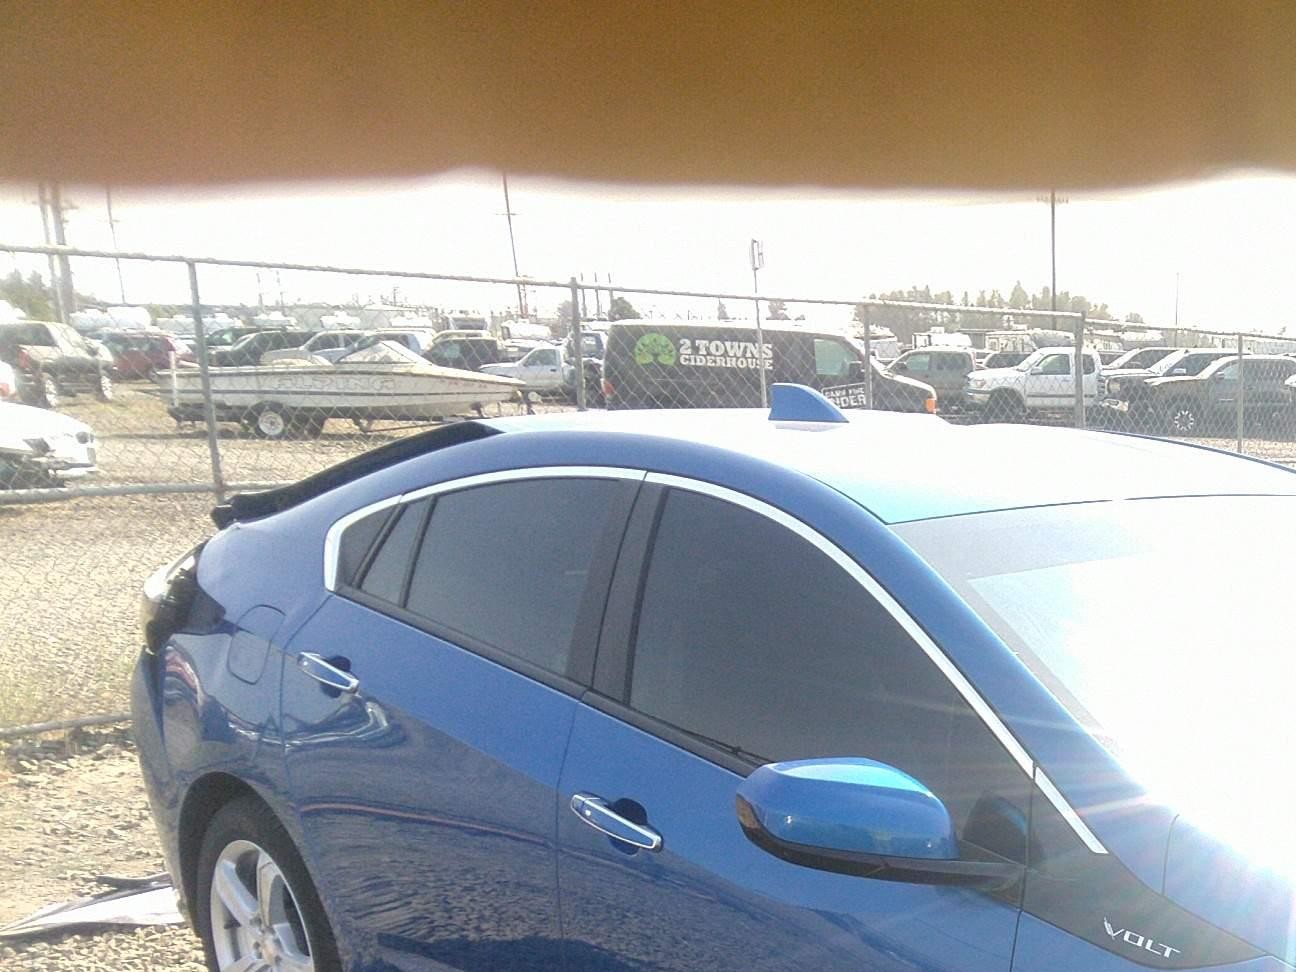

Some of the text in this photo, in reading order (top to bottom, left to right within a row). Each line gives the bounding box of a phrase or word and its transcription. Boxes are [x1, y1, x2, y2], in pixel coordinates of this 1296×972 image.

[679, 338, 774, 359] 2 TOWNS
[679, 354, 774, 371] CIDERHOUSE
[1103, 917, 1181, 958] VOLT
